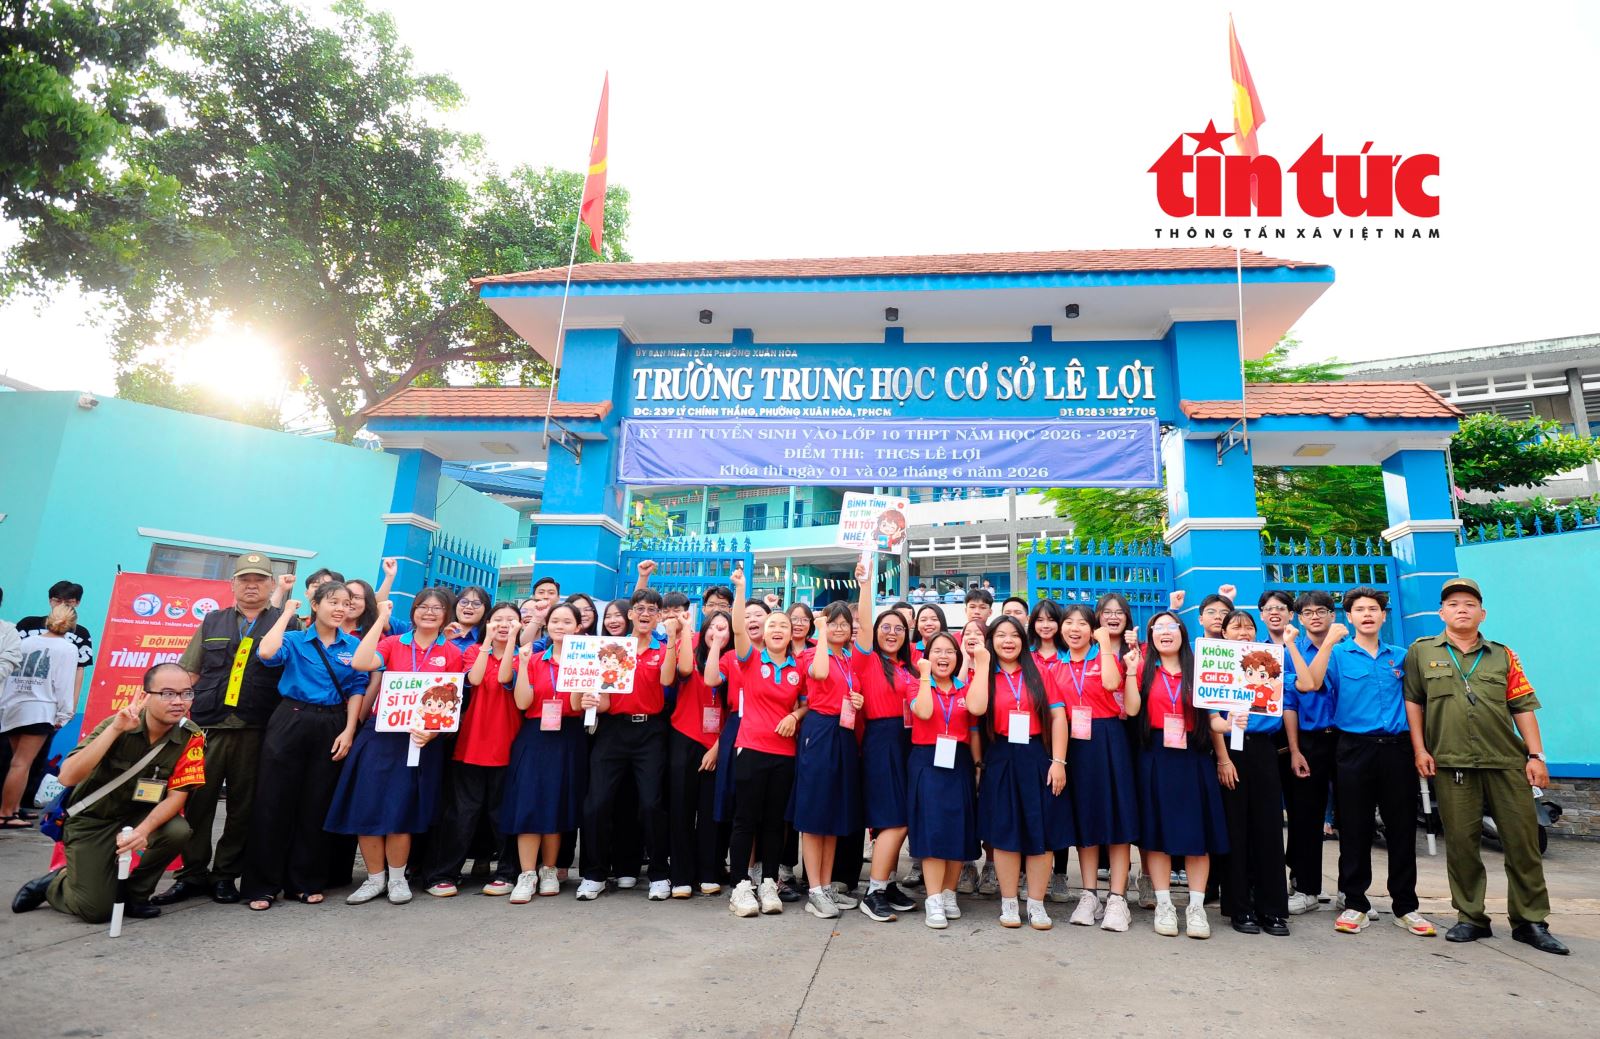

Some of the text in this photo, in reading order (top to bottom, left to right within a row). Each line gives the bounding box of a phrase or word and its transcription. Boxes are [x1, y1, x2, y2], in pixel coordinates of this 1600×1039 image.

[633, 356, 1156, 407] TRƯỜNG TRUNG HỌC CƠ SỞ LÊ LỢI
[634, 408, 652, 416] ĐC:
[654, 408, 674, 416] 239
[676, 405, 686, 416] LÝ
[688, 405, 718, 416] CHÍNH
[760, 405, 800, 416] PHƯỜNG
[802, 406, 830, 416] XUÂN
[857, 408, 892, 416] TPHCM
[640, 424, 661, 440] KỲ
[666, 428, 694, 440] THI
[698, 423, 753, 440] TUYỂN
[758, 428, 797, 440] SINH
[802, 424, 838, 440] VÀO
[843, 424, 876, 440] LỚP
[882, 430, 900, 440] 10
[906, 430, 950, 440] THPT
[956, 428, 994, 440] NĂM
[999, 430, 1036, 444] HỌC
[1041, 430, 1082, 440] 2026
[1096, 430, 1138, 440] 2027
[784, 444, 981, 462] ĐIỂM THI: THCS LÊ LỢI
[720, 464, 1048, 480] Khóa thi ngày 01 và 02 tháng 6 năm 2026
[843, 520, 858, 530] THI
[843, 530, 866, 540] NHÉ!
[148, 636, 165, 646] ĐỘI
[570, 642, 586, 650] THI
[110, 648, 151, 668] TÌNH
[1202, 644, 1234, 658] KHÔNG
[580, 665, 600, 676] SÁNG
[1202, 657, 1236, 672] ÁP LỰC
[390, 676, 422, 690] CỐ LÊN
[564, 676, 578, 687] HẾT
[1219, 674, 1229, 682] CÓ
[387, 690, 419, 706] SĨ TỬ
[1198, 684, 1254, 701] QUYẾT TÂM!
[388, 709, 412, 726] ƠI!
